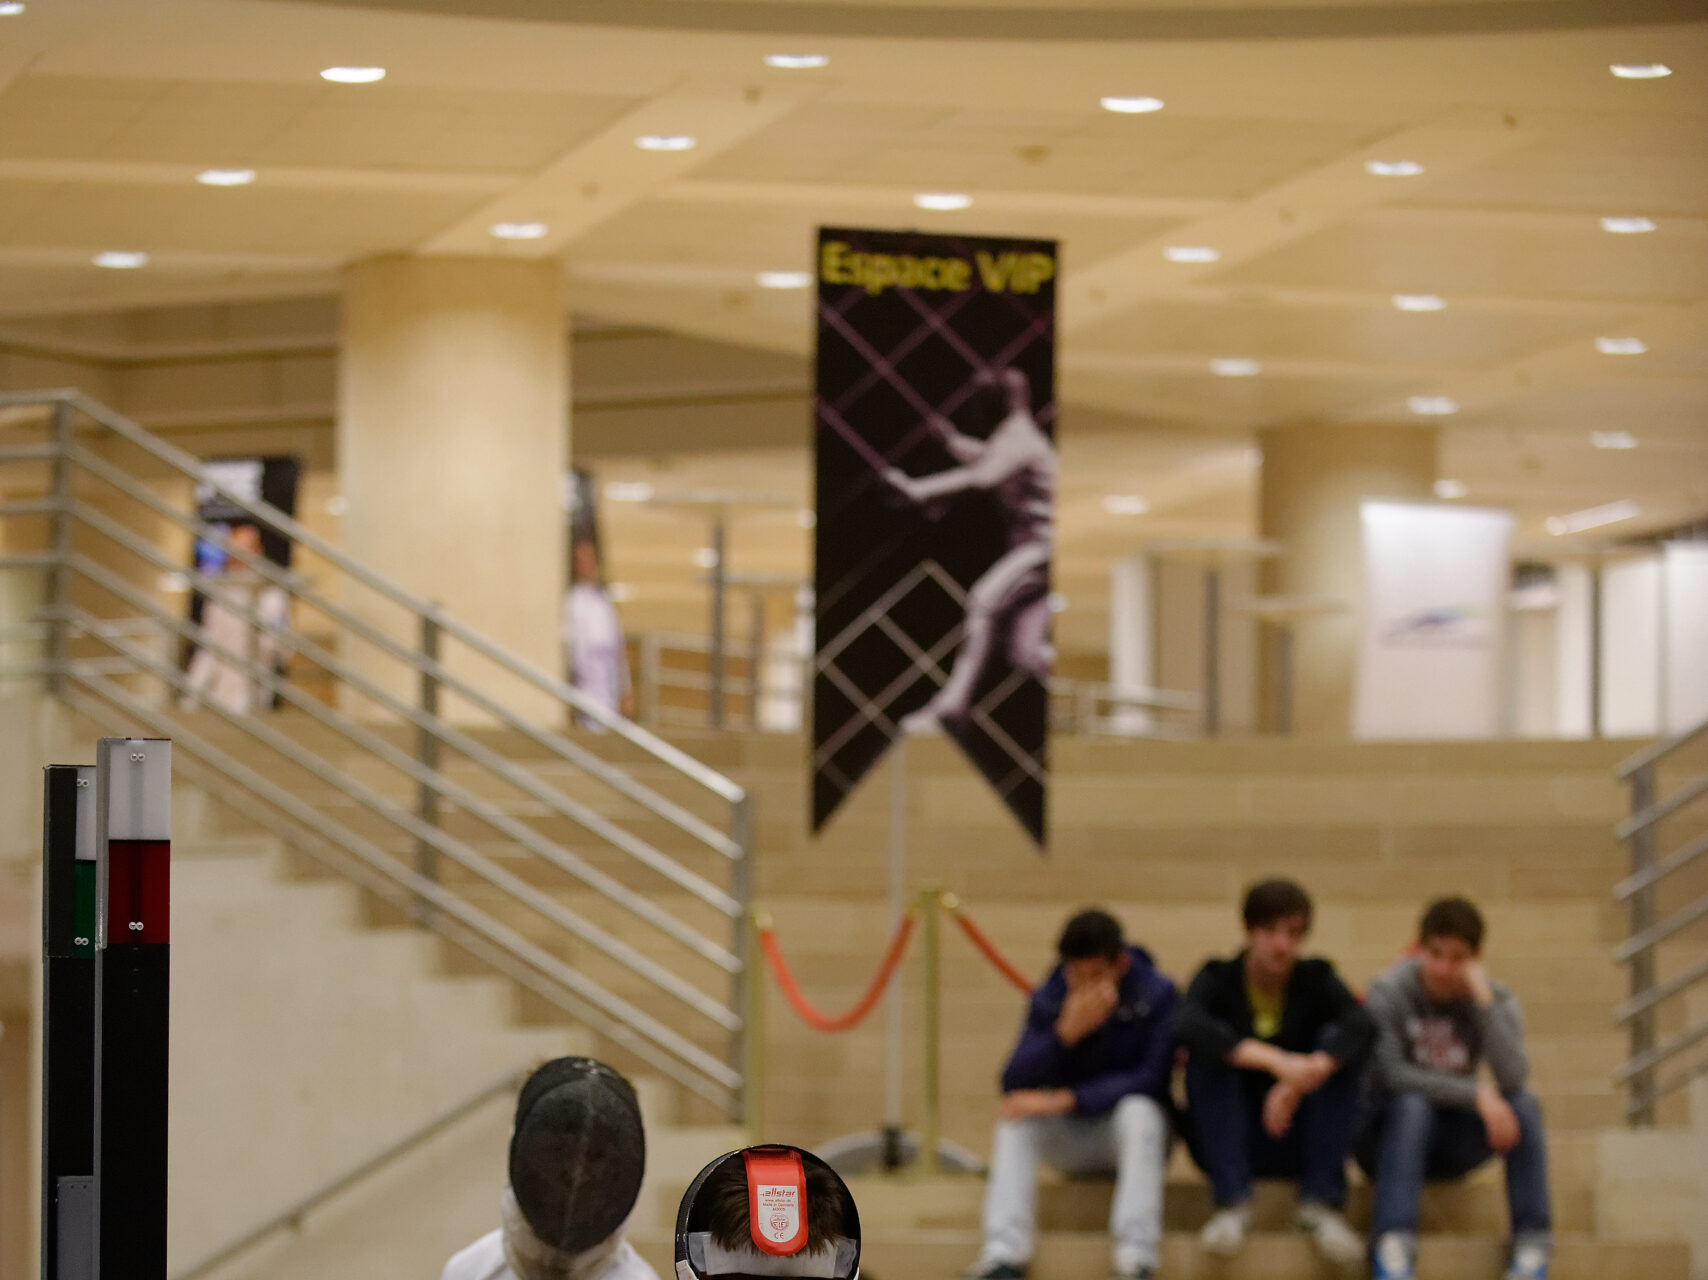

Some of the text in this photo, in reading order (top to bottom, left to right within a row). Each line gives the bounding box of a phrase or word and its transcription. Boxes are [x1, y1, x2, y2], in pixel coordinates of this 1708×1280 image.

[820, 241, 1054, 296] Espace VIP
[763, 1187, 796, 1198] allstar
